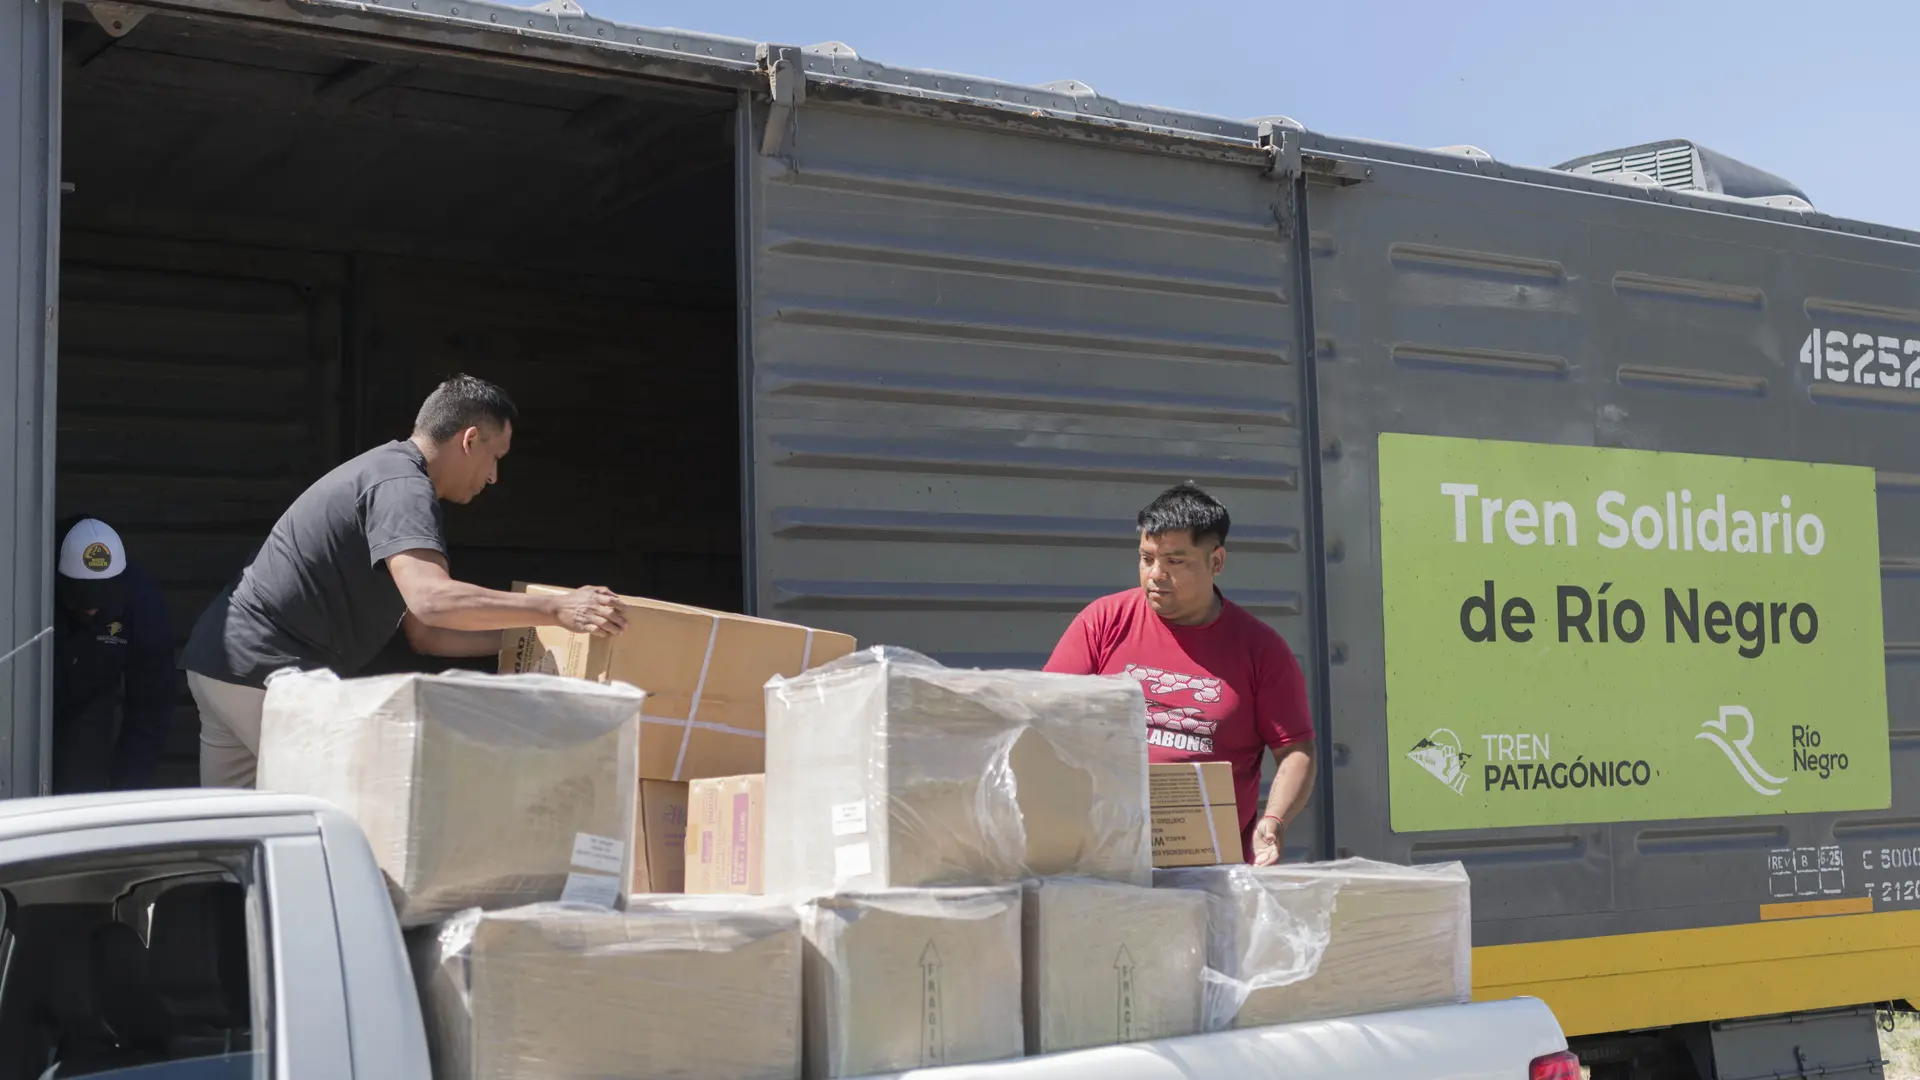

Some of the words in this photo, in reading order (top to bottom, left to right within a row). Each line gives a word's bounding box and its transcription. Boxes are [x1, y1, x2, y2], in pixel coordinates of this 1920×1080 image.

[1440, 481, 1578, 547] Tren
[1596, 488, 1826, 557] Solidario
[1459, 580, 1536, 643] de
[1556, 582, 1646, 644] Río
[1665, 587, 1819, 659] Negro
[1481, 733, 1551, 761] TREN
[1791, 724, 1821, 748] Río
[1484, 754, 1651, 791] PATAGÓNICO
[1792, 748, 1849, 780] Negro
[1771, 856, 1791, 869] REV
[1862, 850, 1873, 870] C
